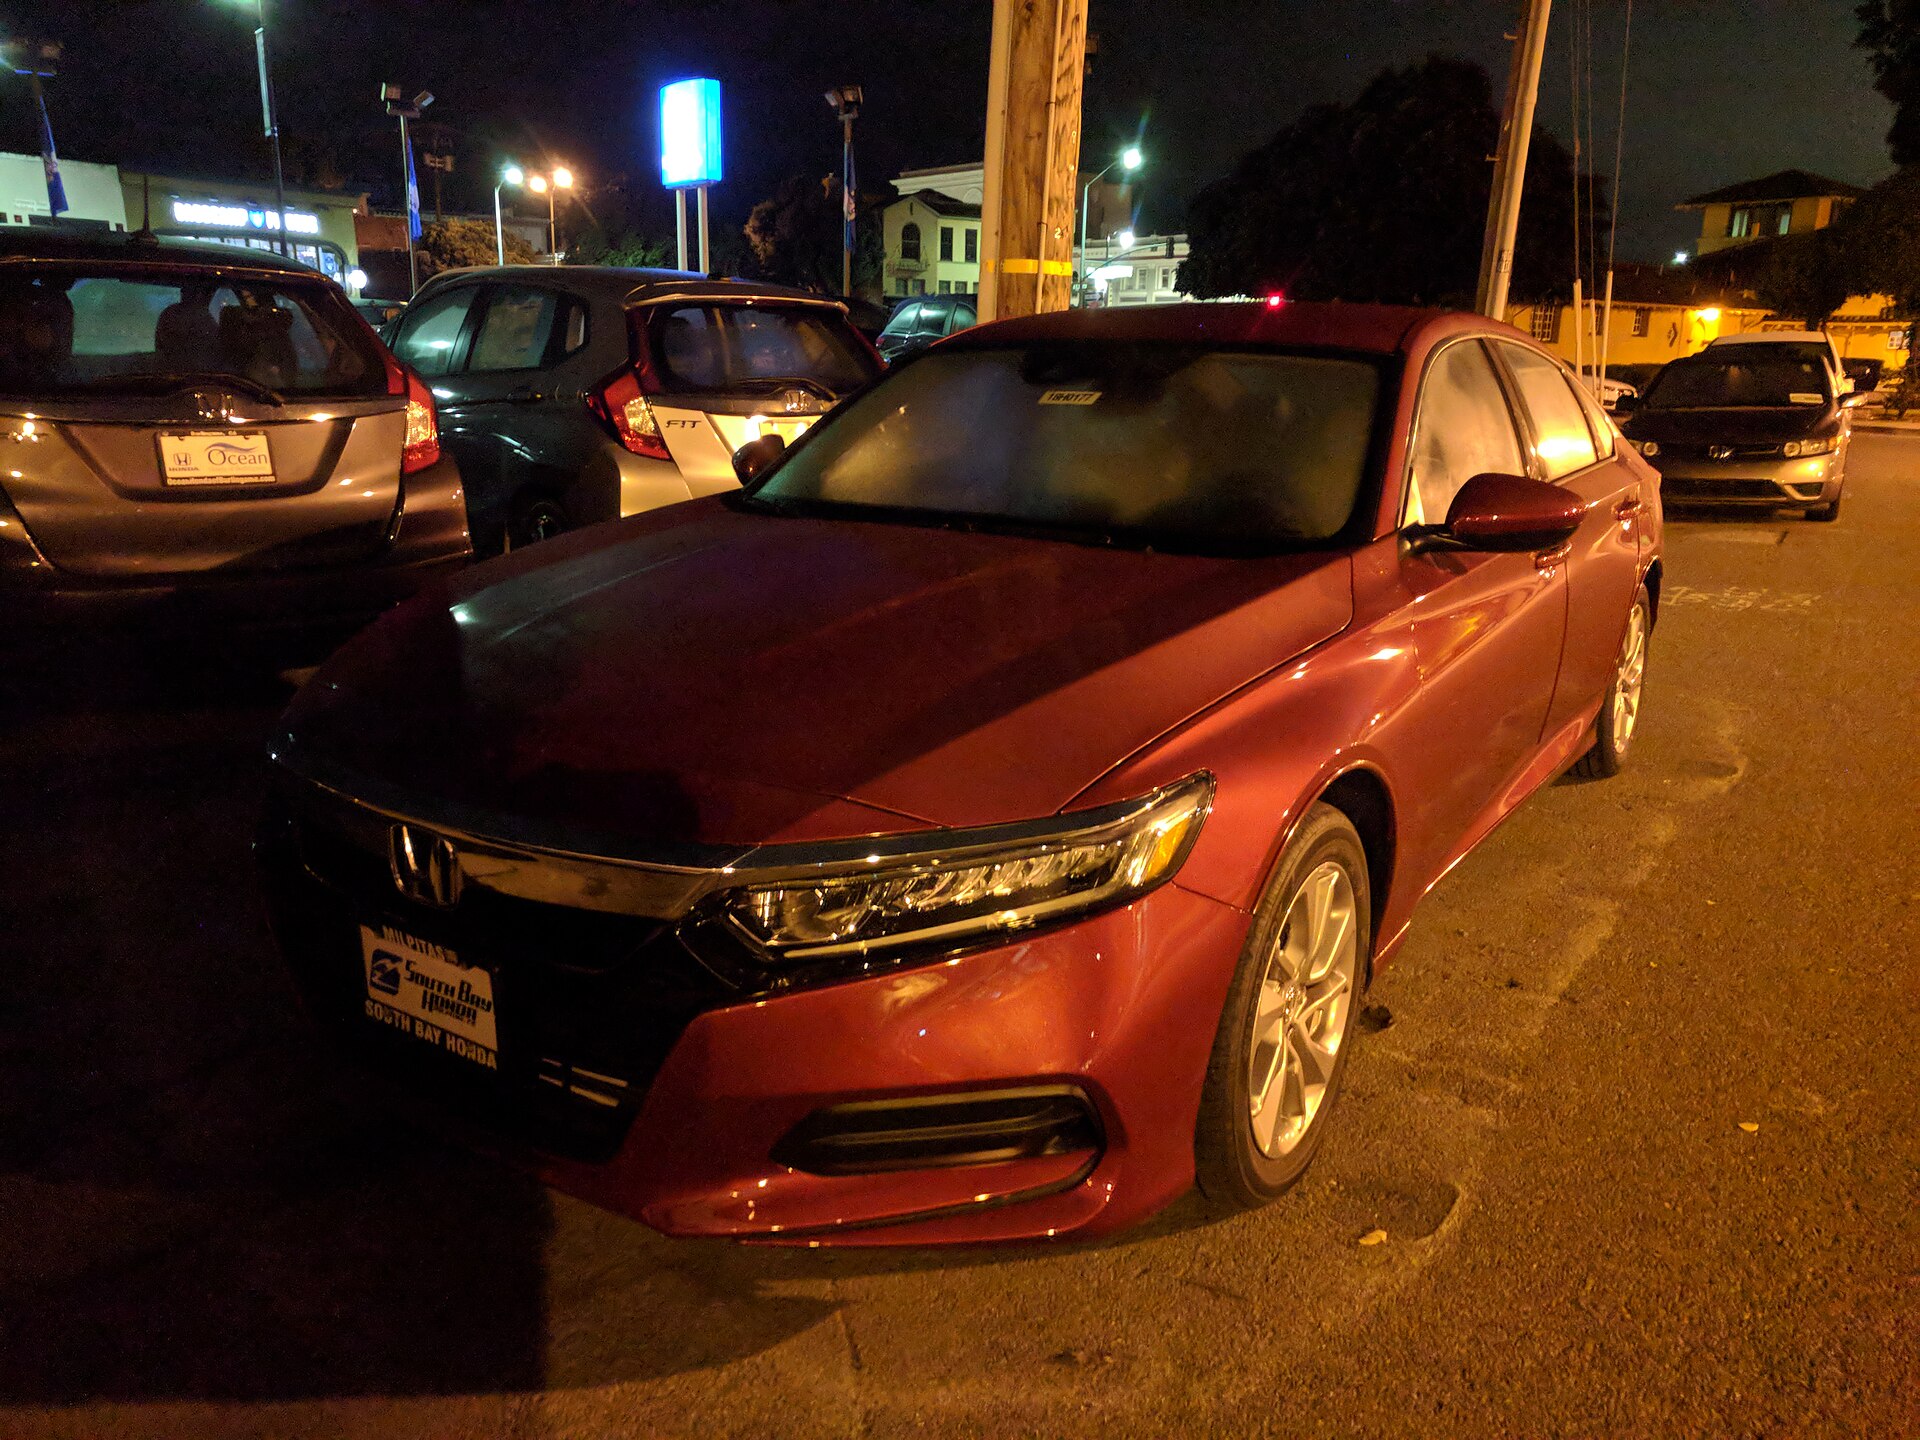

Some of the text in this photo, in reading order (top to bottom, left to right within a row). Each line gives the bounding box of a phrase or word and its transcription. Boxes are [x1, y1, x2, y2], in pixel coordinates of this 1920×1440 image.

[665, 420, 702, 428] FIT
[207, 448, 268, 465] Ocean
[382, 925, 446, 961] MILPITAS
[364, 999, 411, 1033] SOUTH
[415, 1019, 442, 1045] BAY
[446, 1034, 498, 1071] HONDA
